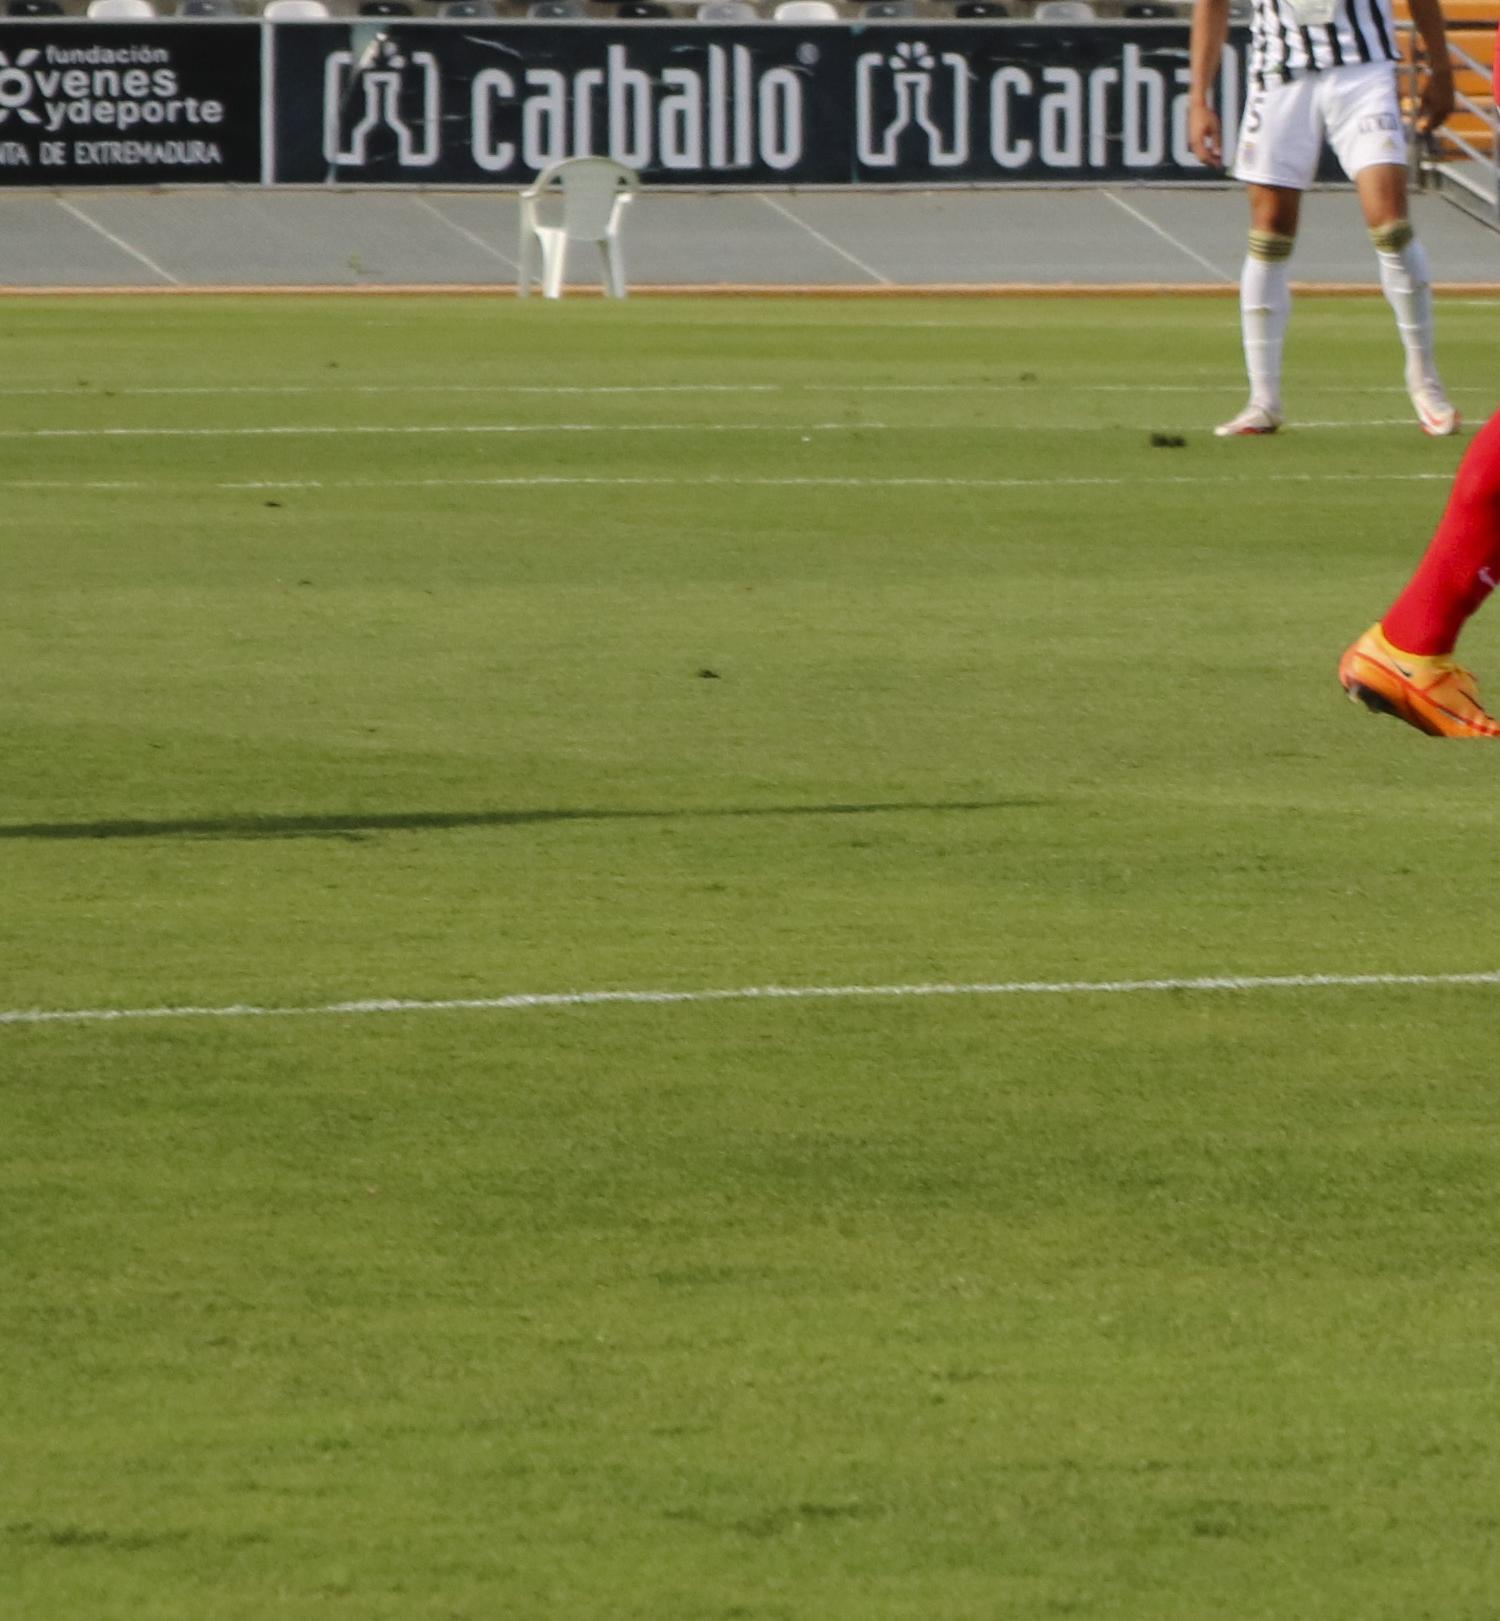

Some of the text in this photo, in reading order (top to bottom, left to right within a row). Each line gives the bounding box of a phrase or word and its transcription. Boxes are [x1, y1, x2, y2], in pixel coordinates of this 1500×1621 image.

[46, 44, 169, 65] fundación
[471, 43, 802, 171] carballo
[39, 141, 67, 165] DE
[74, 139, 223, 166] EXTREMADURA
